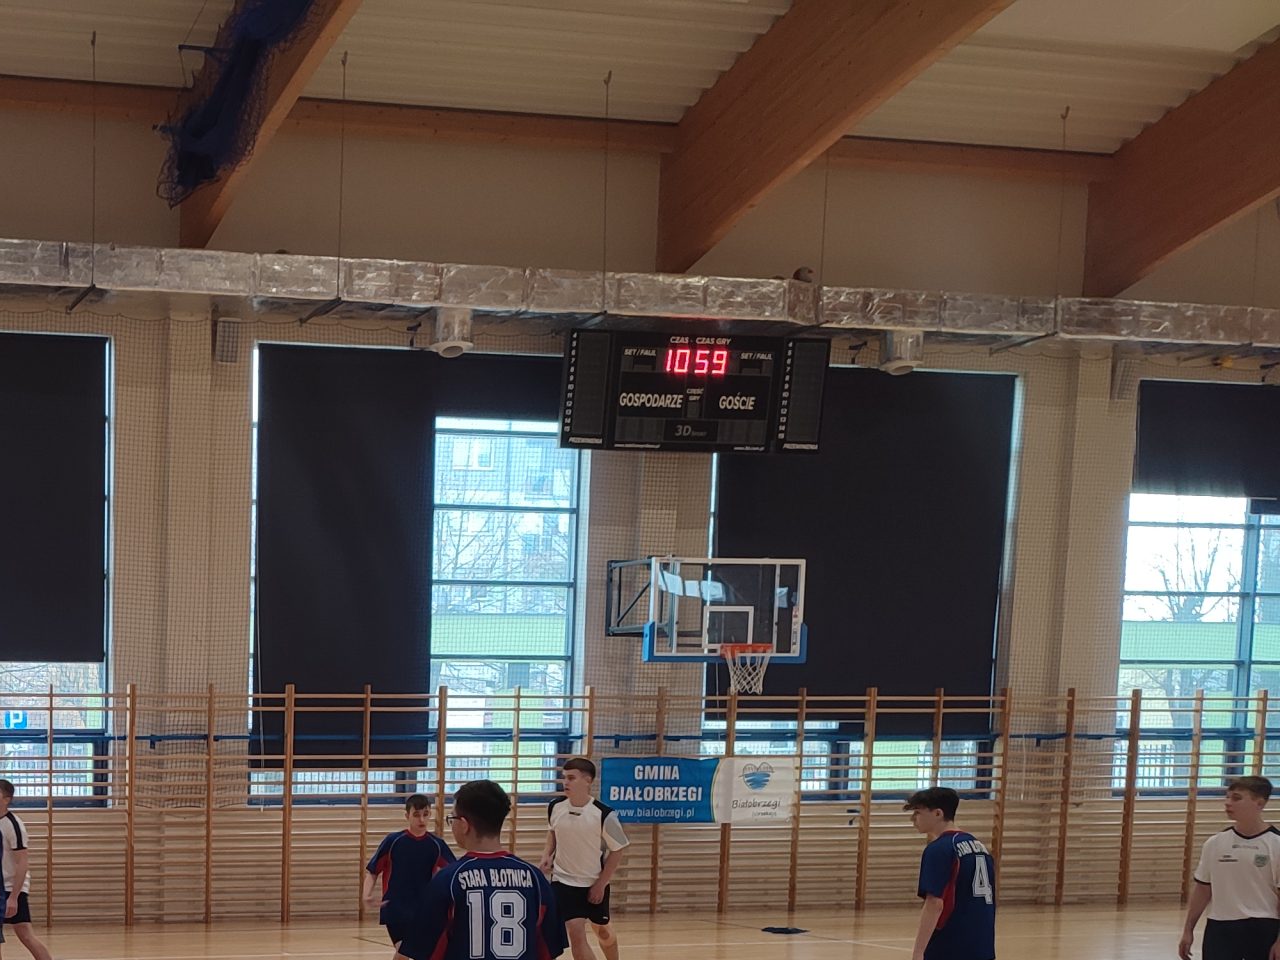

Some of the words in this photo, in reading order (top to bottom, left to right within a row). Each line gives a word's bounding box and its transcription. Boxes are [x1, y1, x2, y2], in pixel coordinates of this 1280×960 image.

[669, 336, 689, 344] CZAS
[695, 337, 715, 345] CZAS
[619, 392, 684, 409] GOSPODARZE
[719, 391, 756, 410] GOŚCIE
[9, 710, 24, 729] P
[634, 765, 680, 780] GMINA
[609, 785, 703, 802] BIAŁOBRZEGI
[458, 868, 489, 890] STARA
[489, 868, 534, 889] BŁOTNICA
[972, 854, 994, 905] 4
[466, 888, 528, 960] 18
